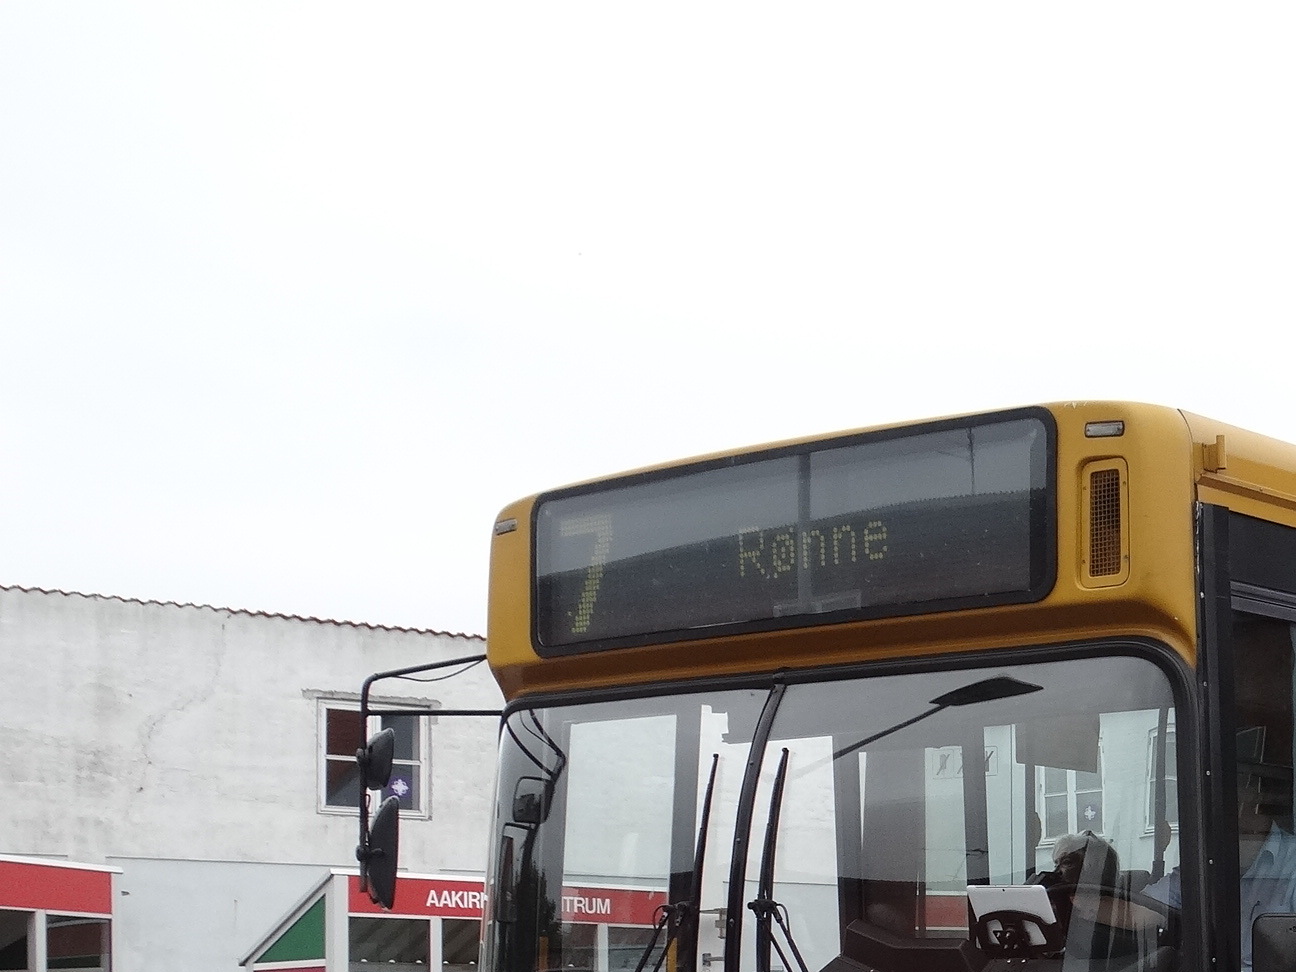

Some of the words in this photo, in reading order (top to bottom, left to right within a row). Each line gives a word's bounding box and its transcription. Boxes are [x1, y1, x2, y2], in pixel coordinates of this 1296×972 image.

[558, 511, 613, 634] 7
[737, 517, 889, 580] Rønne
[561, 896, 611, 915] TRUM
